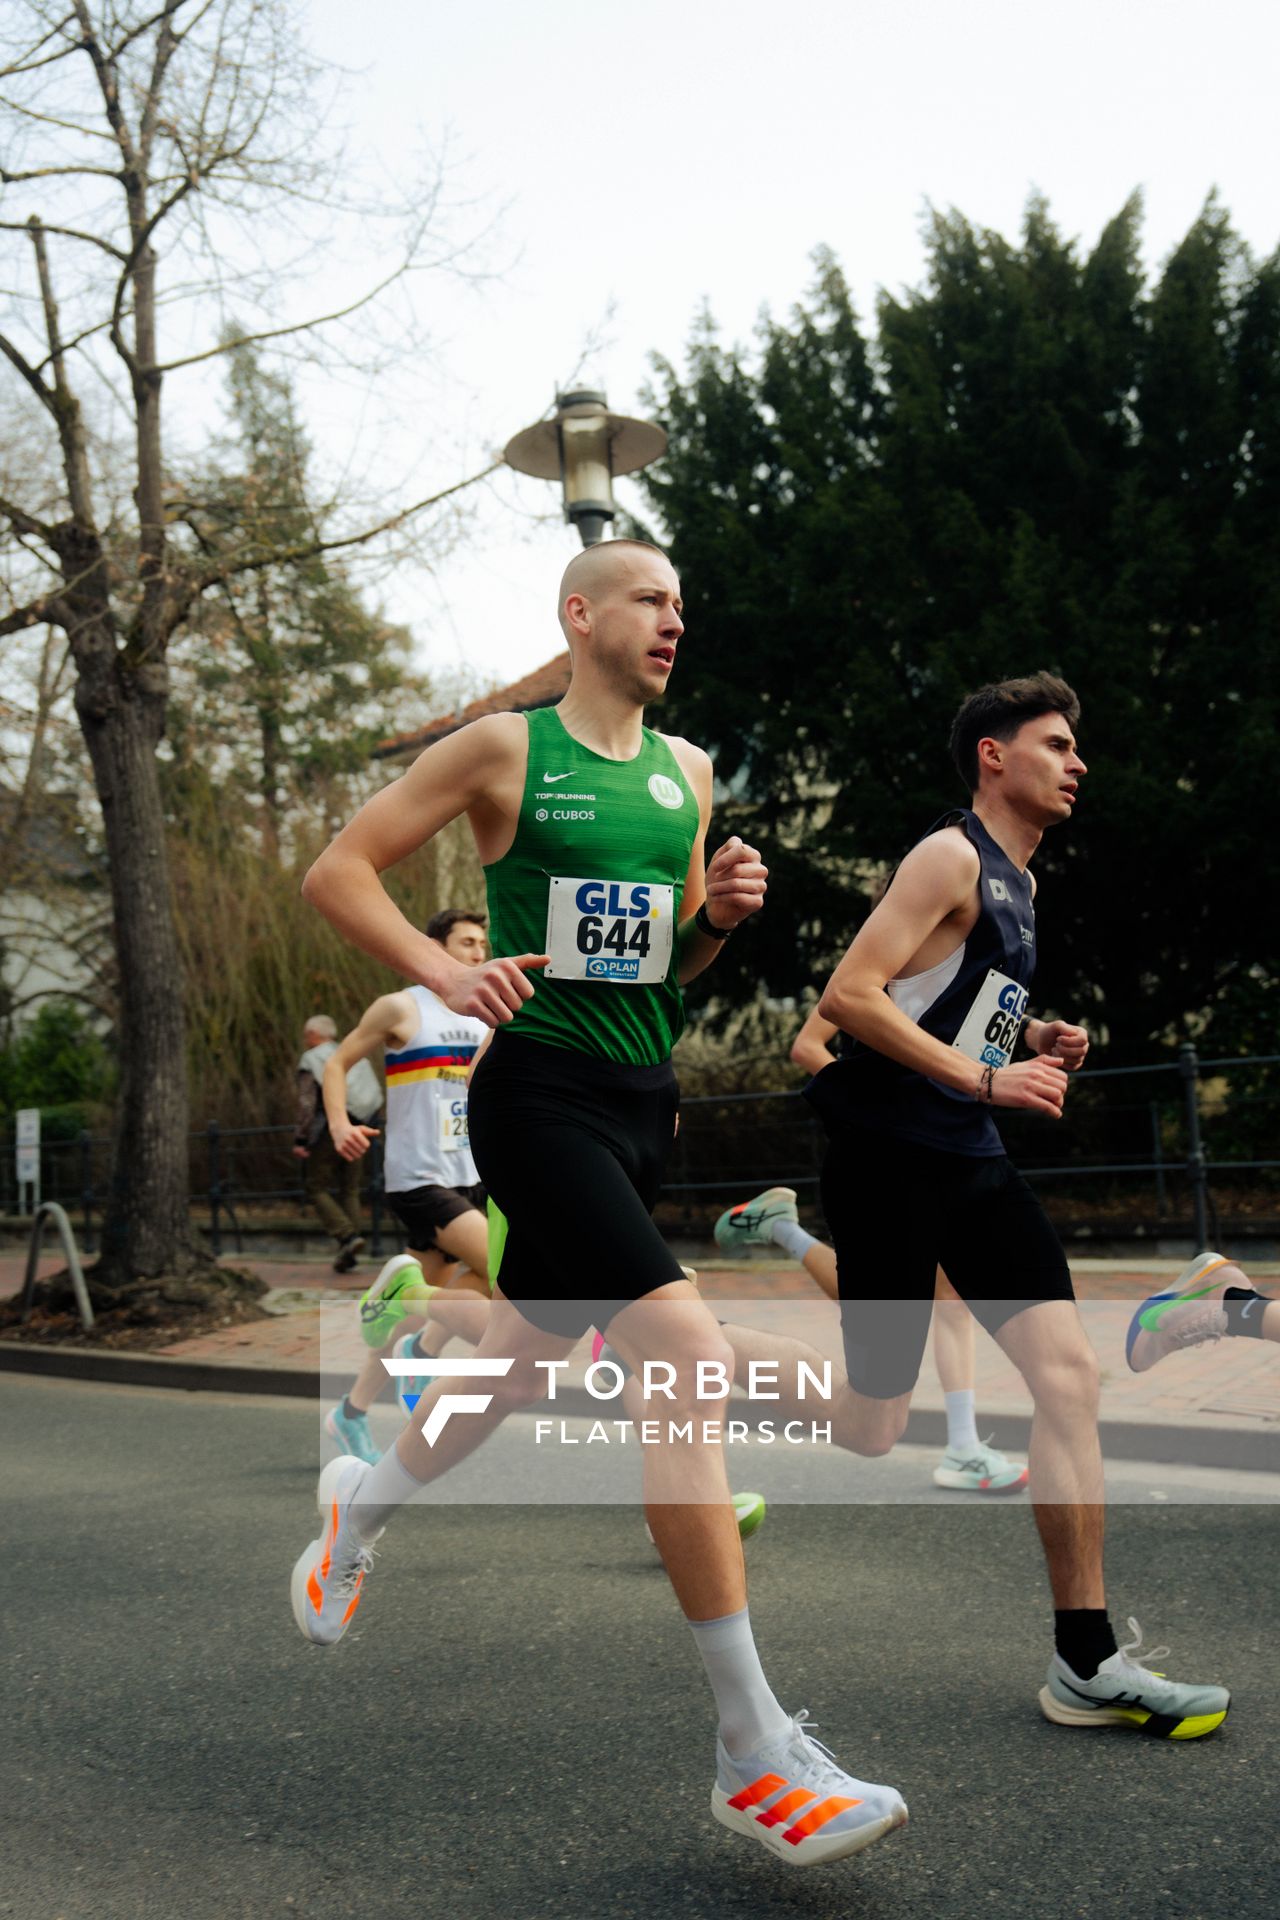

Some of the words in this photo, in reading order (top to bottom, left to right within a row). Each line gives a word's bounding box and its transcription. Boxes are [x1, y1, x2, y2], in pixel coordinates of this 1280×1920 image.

[552, 810, 596, 821] CUBOS
[576, 915, 651, 958] 644
[608, 962, 638, 973] PLAN
